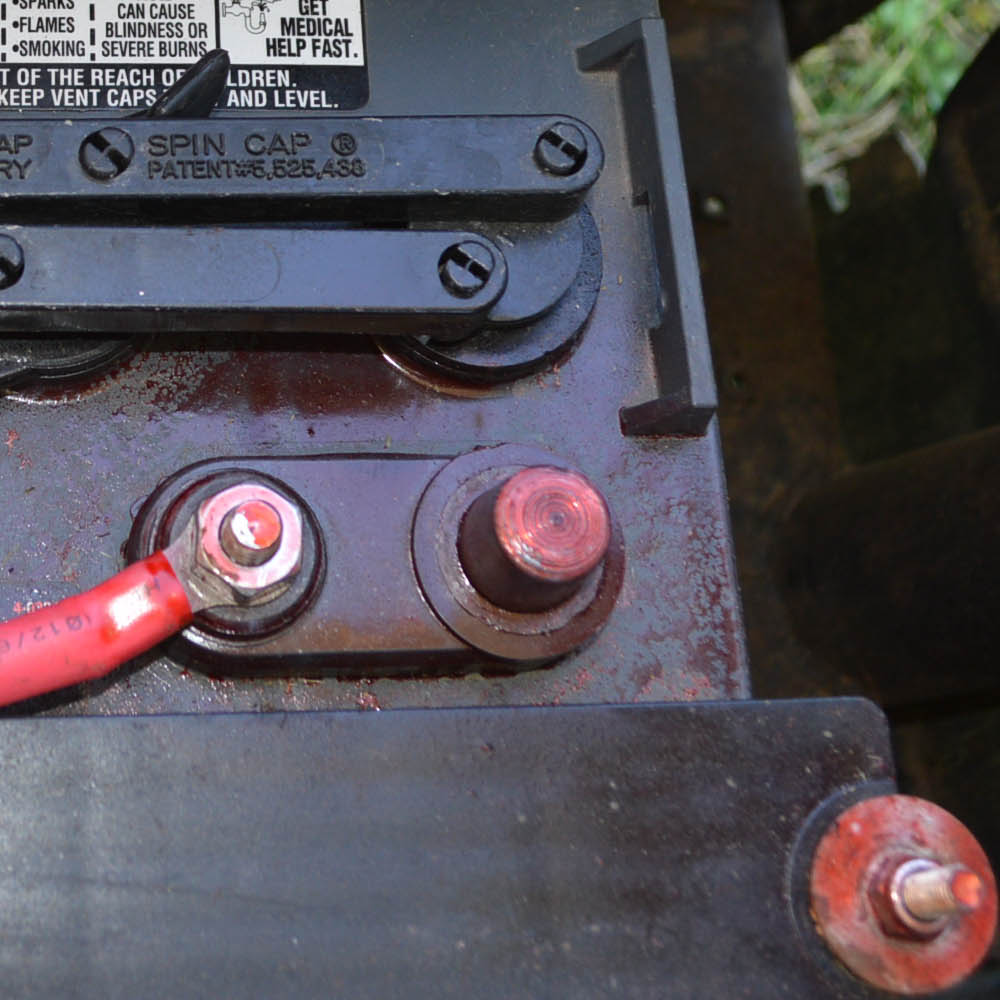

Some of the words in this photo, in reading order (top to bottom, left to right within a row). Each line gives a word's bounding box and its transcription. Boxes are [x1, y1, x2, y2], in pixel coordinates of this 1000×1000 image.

[117, 3, 145, 20] CAN
[150, 4, 195, 20] CAUSE
[105, 22, 184, 39] BLINDNESS
[188, 23, 208, 38] OR
[280, 17, 354, 37] MEDICAL
[101, 41, 155, 57] SEVERE
[266, 37, 307, 58] HELP
[312, 39, 359, 59] FAST.
[17, 68, 41, 87] OF
[47, 68, 86, 87] THE
[91, 68, 155, 87] REACH
[50, 89, 101, 107] VENT
[107, 89, 157, 107] CAPS
[227, 90, 267, 108] AND
[274, 90, 339, 109] LEVEL.
[148, 133, 226, 157] SPIN
[244, 133, 312, 156] CAP
